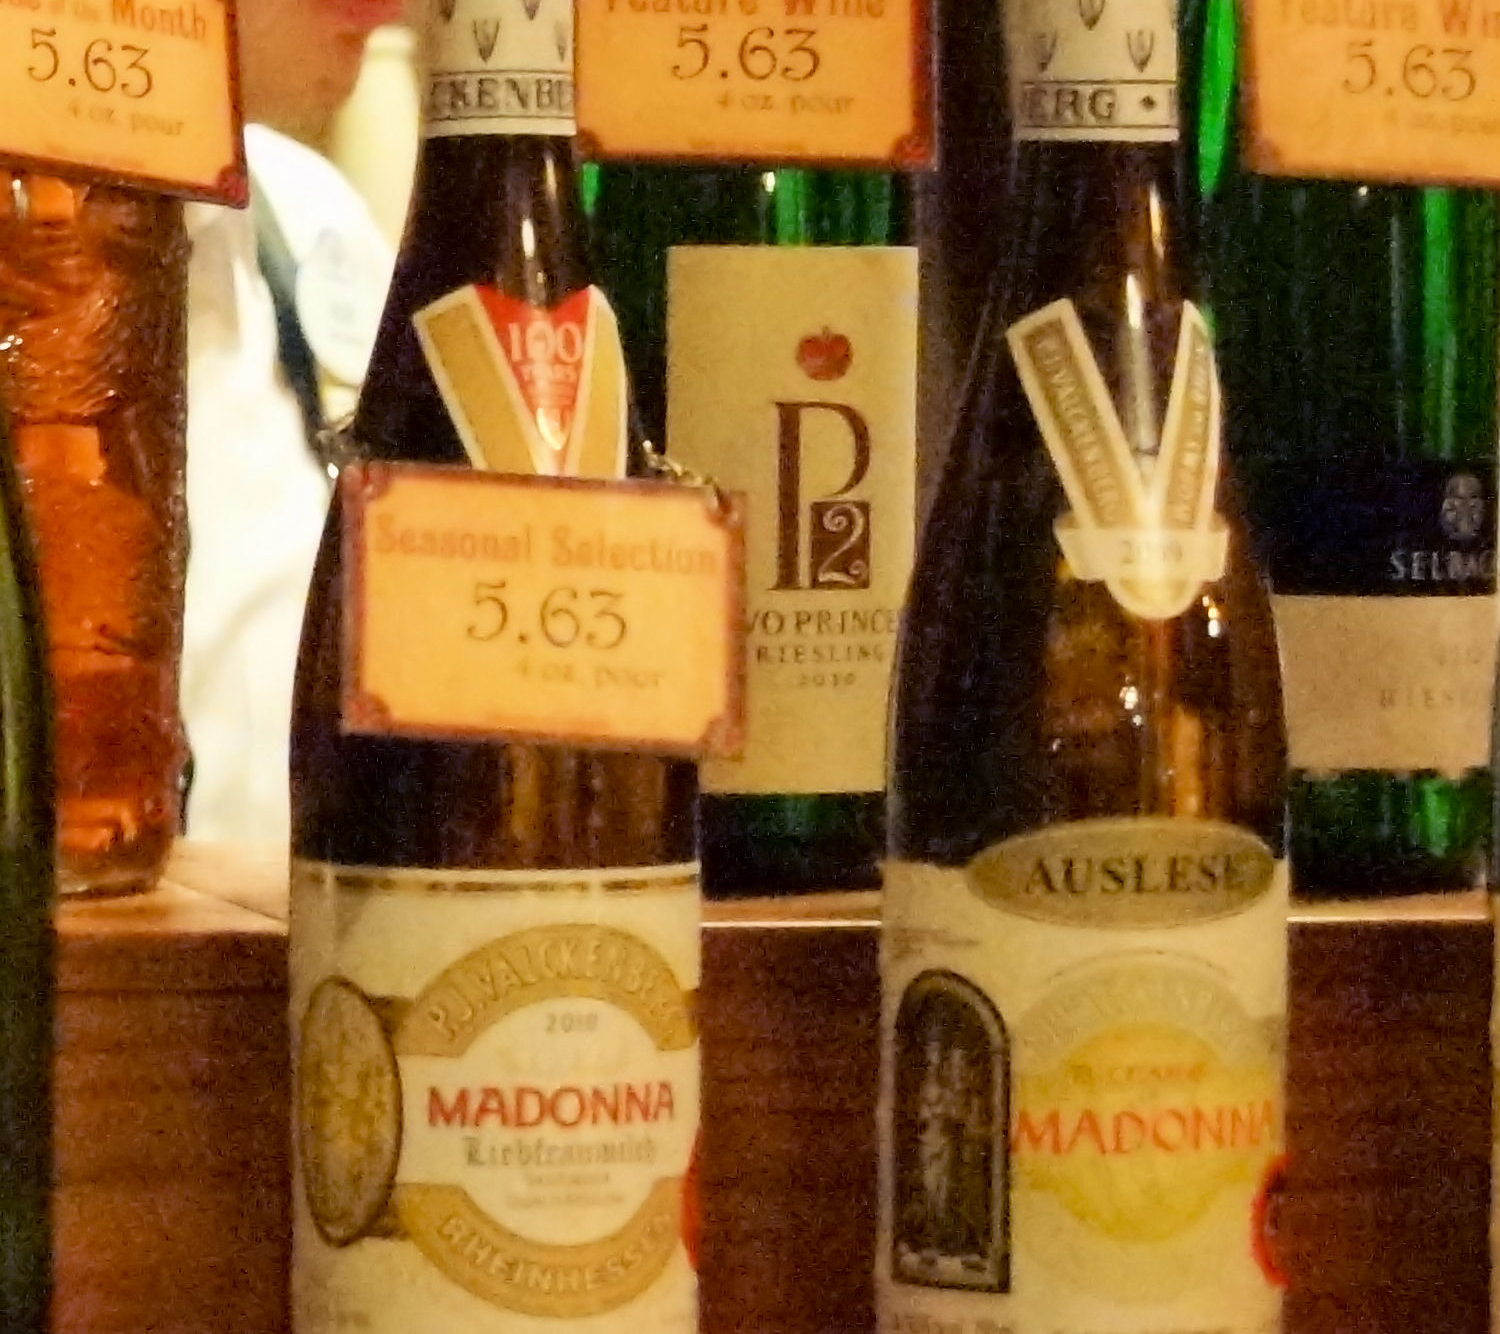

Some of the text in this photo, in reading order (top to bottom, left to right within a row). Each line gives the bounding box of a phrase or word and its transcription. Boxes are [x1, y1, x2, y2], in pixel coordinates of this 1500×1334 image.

[27, 27, 154, 99] 5.63
[672, 22, 823, 82] 5.63
[1340, 40, 1478, 103] 5.63
[466, 579, 629, 652] 5.63
[1024, 854, 1249, 898] AUSLESE
[427, 1081, 675, 1129] MADONNA
[1010, 1099, 1276, 1157] MADONNA
